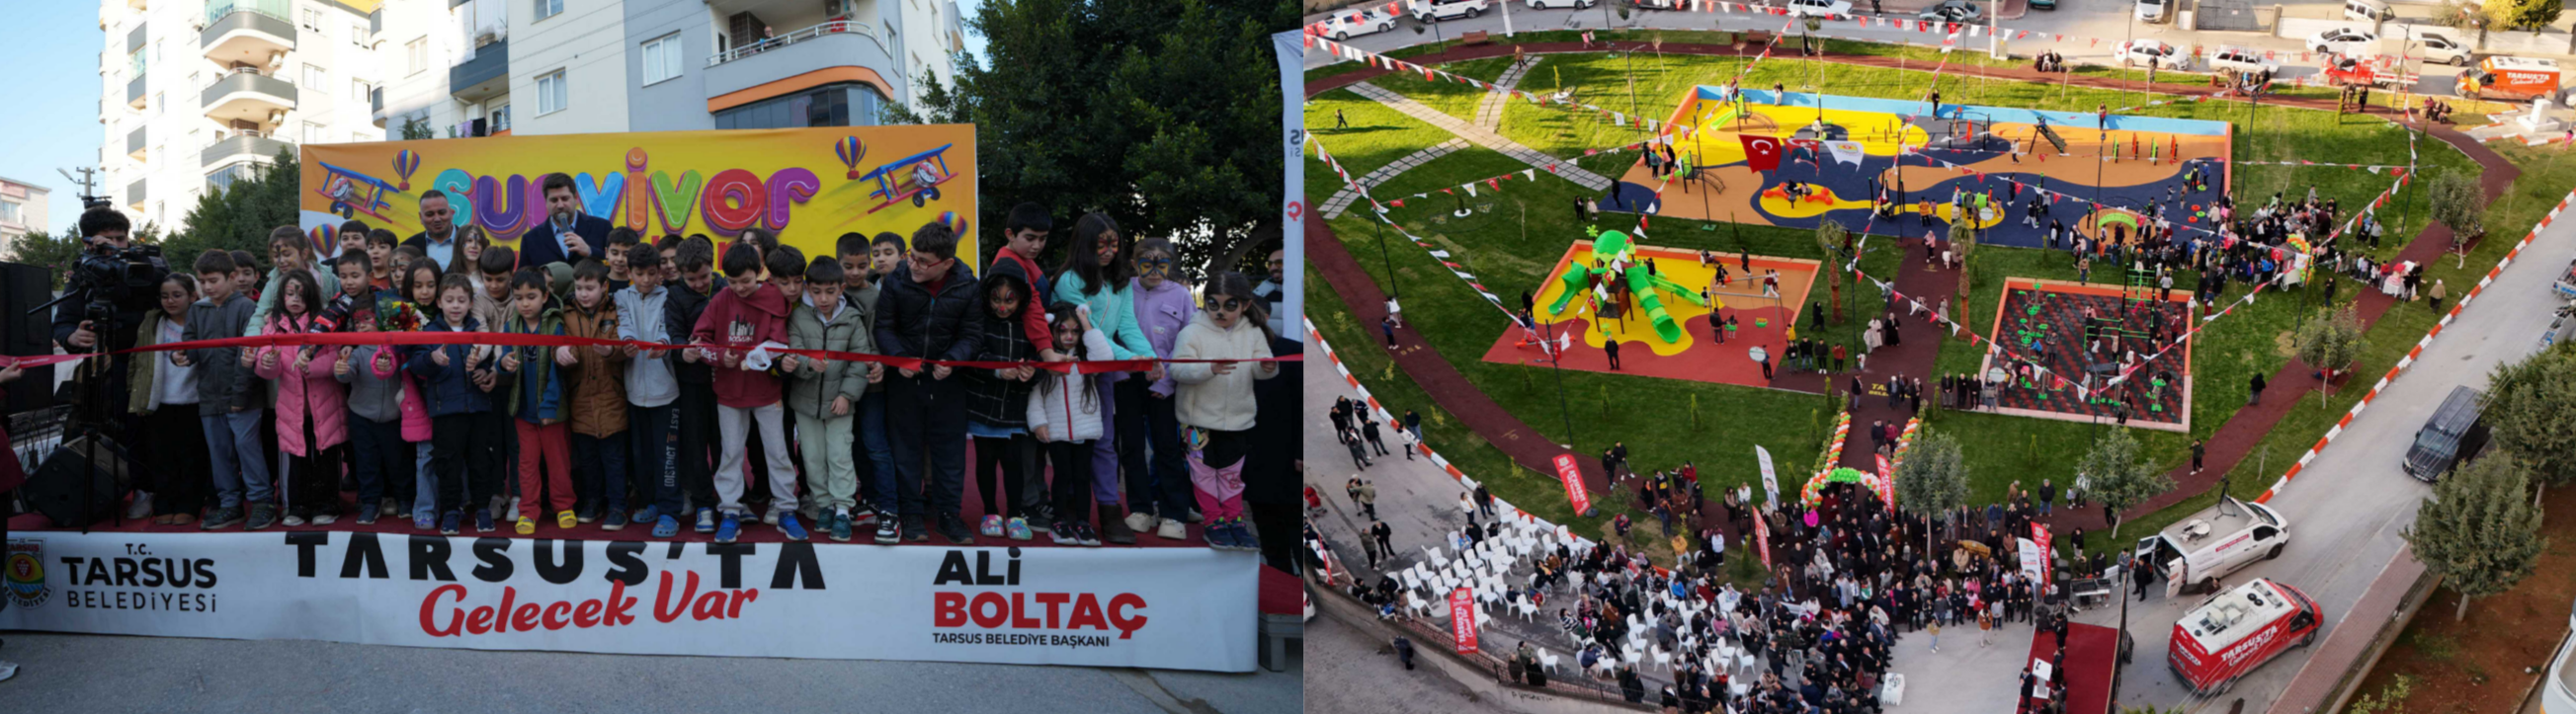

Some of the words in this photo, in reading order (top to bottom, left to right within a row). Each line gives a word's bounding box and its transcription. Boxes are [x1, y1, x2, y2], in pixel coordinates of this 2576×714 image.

[125, 543, 152, 556] T.C.
[285, 531, 826, 591] TARSUS'TA
[60, 556, 217, 590] TARSUS
[67, 591, 216, 613] BELEDİYESİ
[419, 579, 639, 637] Gelecek
[653, 570, 759, 623] Var
[934, 591, 1148, 640] BOLTAÇ
[932, 632, 982, 644] TARSUS
[985, 633, 1047, 646] BELEDİYE
[1050, 635, 1110, 649] BAŞKANI
